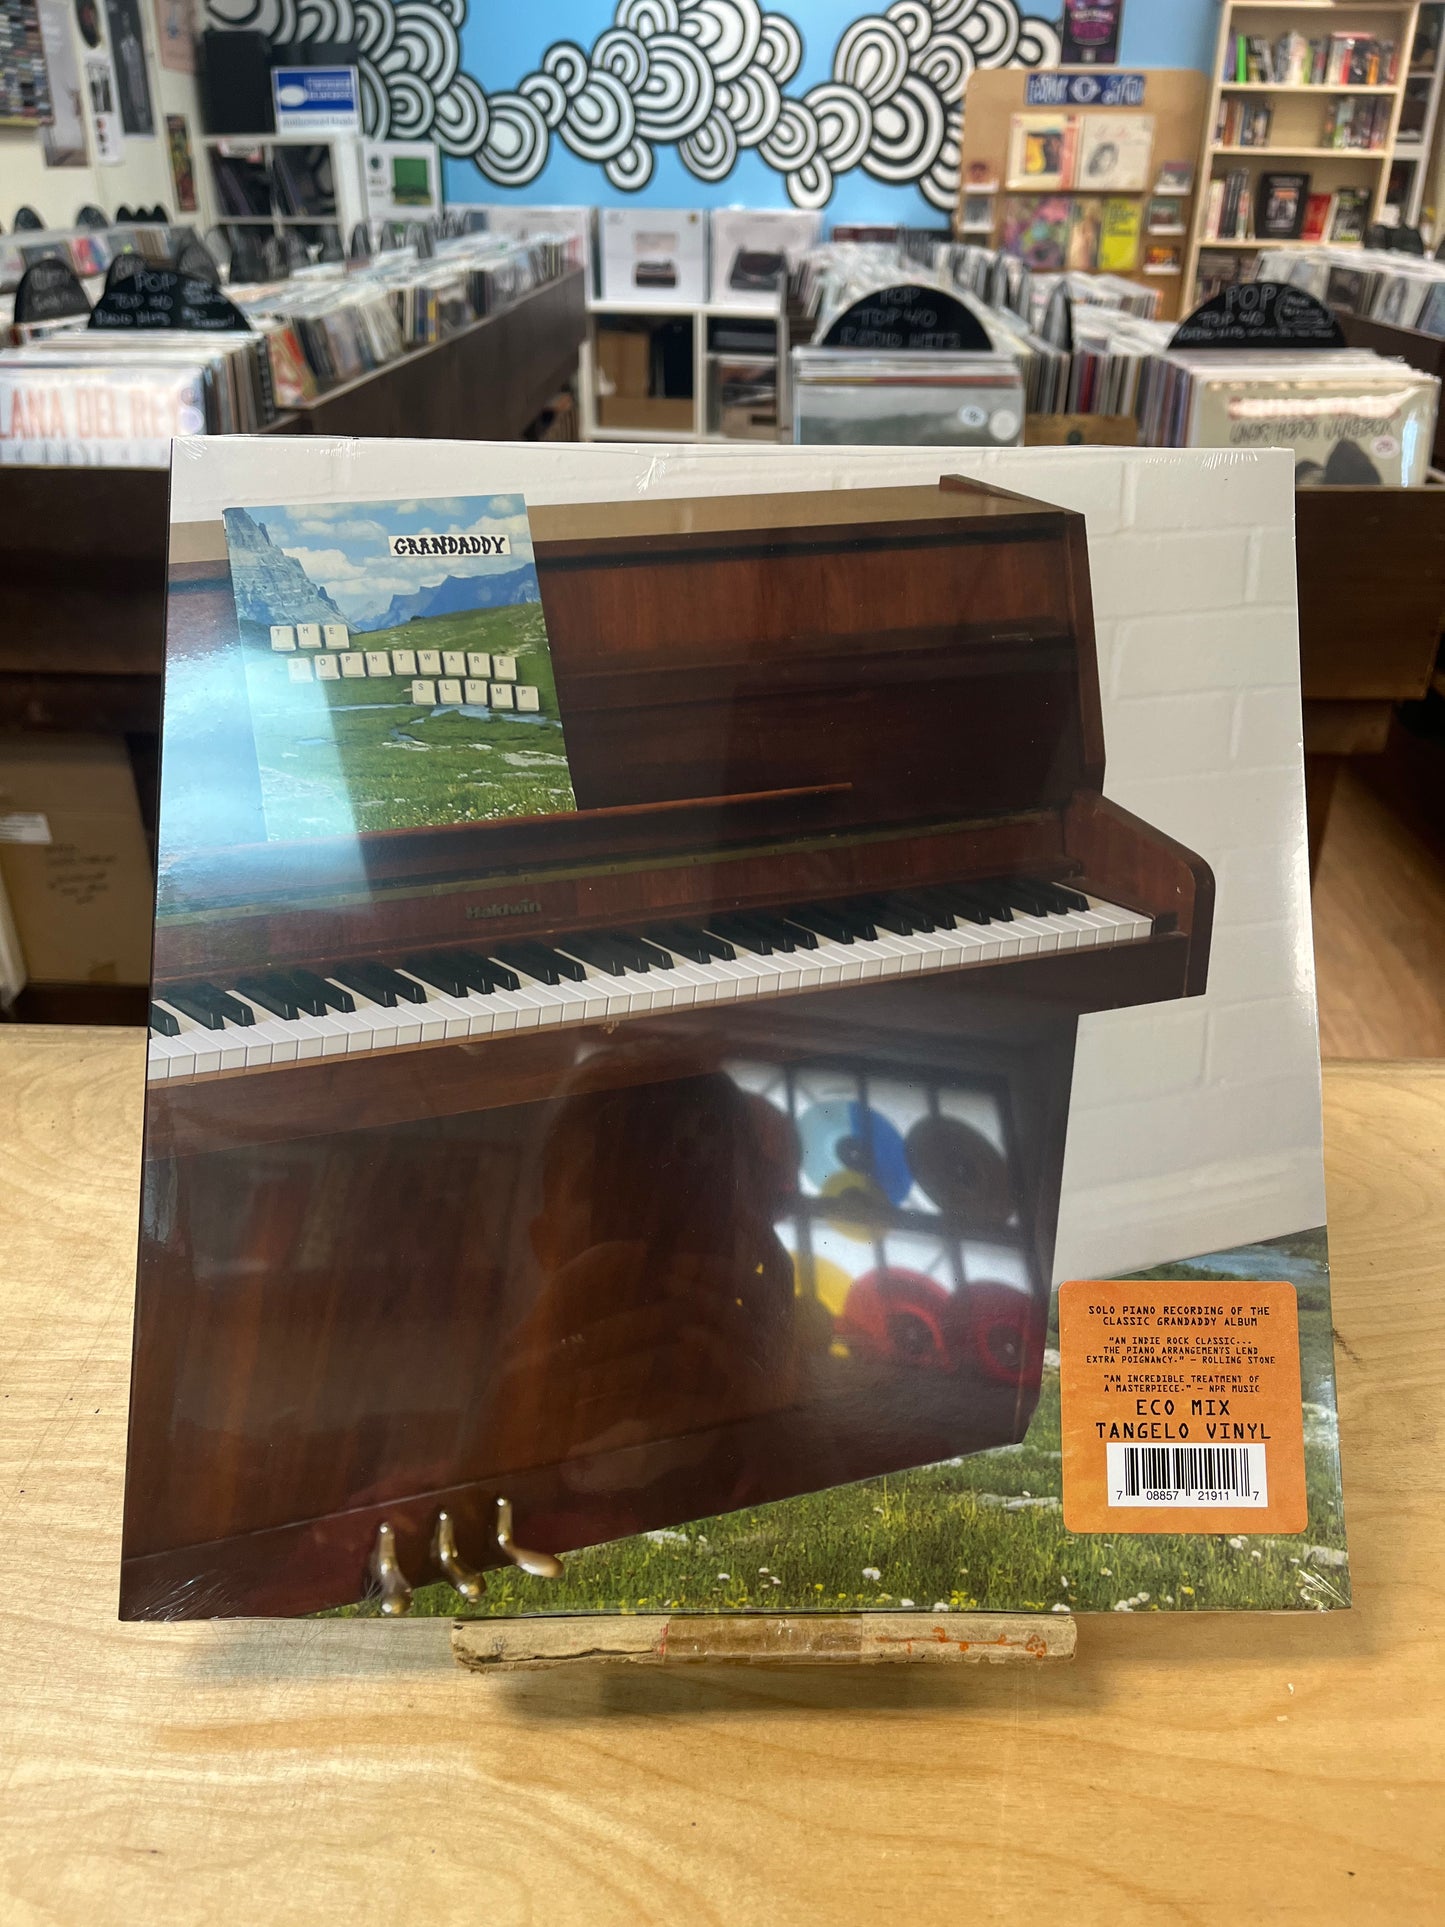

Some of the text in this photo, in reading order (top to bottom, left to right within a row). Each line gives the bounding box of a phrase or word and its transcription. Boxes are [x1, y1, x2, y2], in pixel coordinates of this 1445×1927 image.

[1226, 284, 1278, 311] POP
[855, 307, 938, 328] TOP 40
[75, 386, 124, 440] DEL
[393, 535, 506, 556] GRANDADDY
[1088, 1305, 1270, 1316] SOLO PIANO RECORDING OF THE
[1103, 1316, 1258, 1327] CLASSIC GRANDADDY ALBUM
[1132, 1336, 1160, 1345] INDIE
[1166, 1336, 1189, 1345] ROCK
[1103, 1346, 1259, 1355] THE PIANO ARRANGEMENTS LEND
[1086, 1355, 1115, 1364] EXTRA
[1202, 1355, 1242, 1365] ROLLING
[1247, 1356, 1276, 1365] STONE
[1127, 1374, 1185, 1383] INCREDIBLE
[1191, 1374, 1243, 1383] TREATMENT
[1249, 1375, 1260, 1383] OF
[1104, 1384, 1110, 1393] A
[1209, 1385, 1226, 1393] NPR
[1231, 1385, 1260, 1393] MUSIC
[1136, 1399, 1231, 1417] ECO MIX
[1095, 1422, 1272, 1440] TANGELO VINYL
[1116, 1490, 1260, 1501] 7 08857 21911 7
